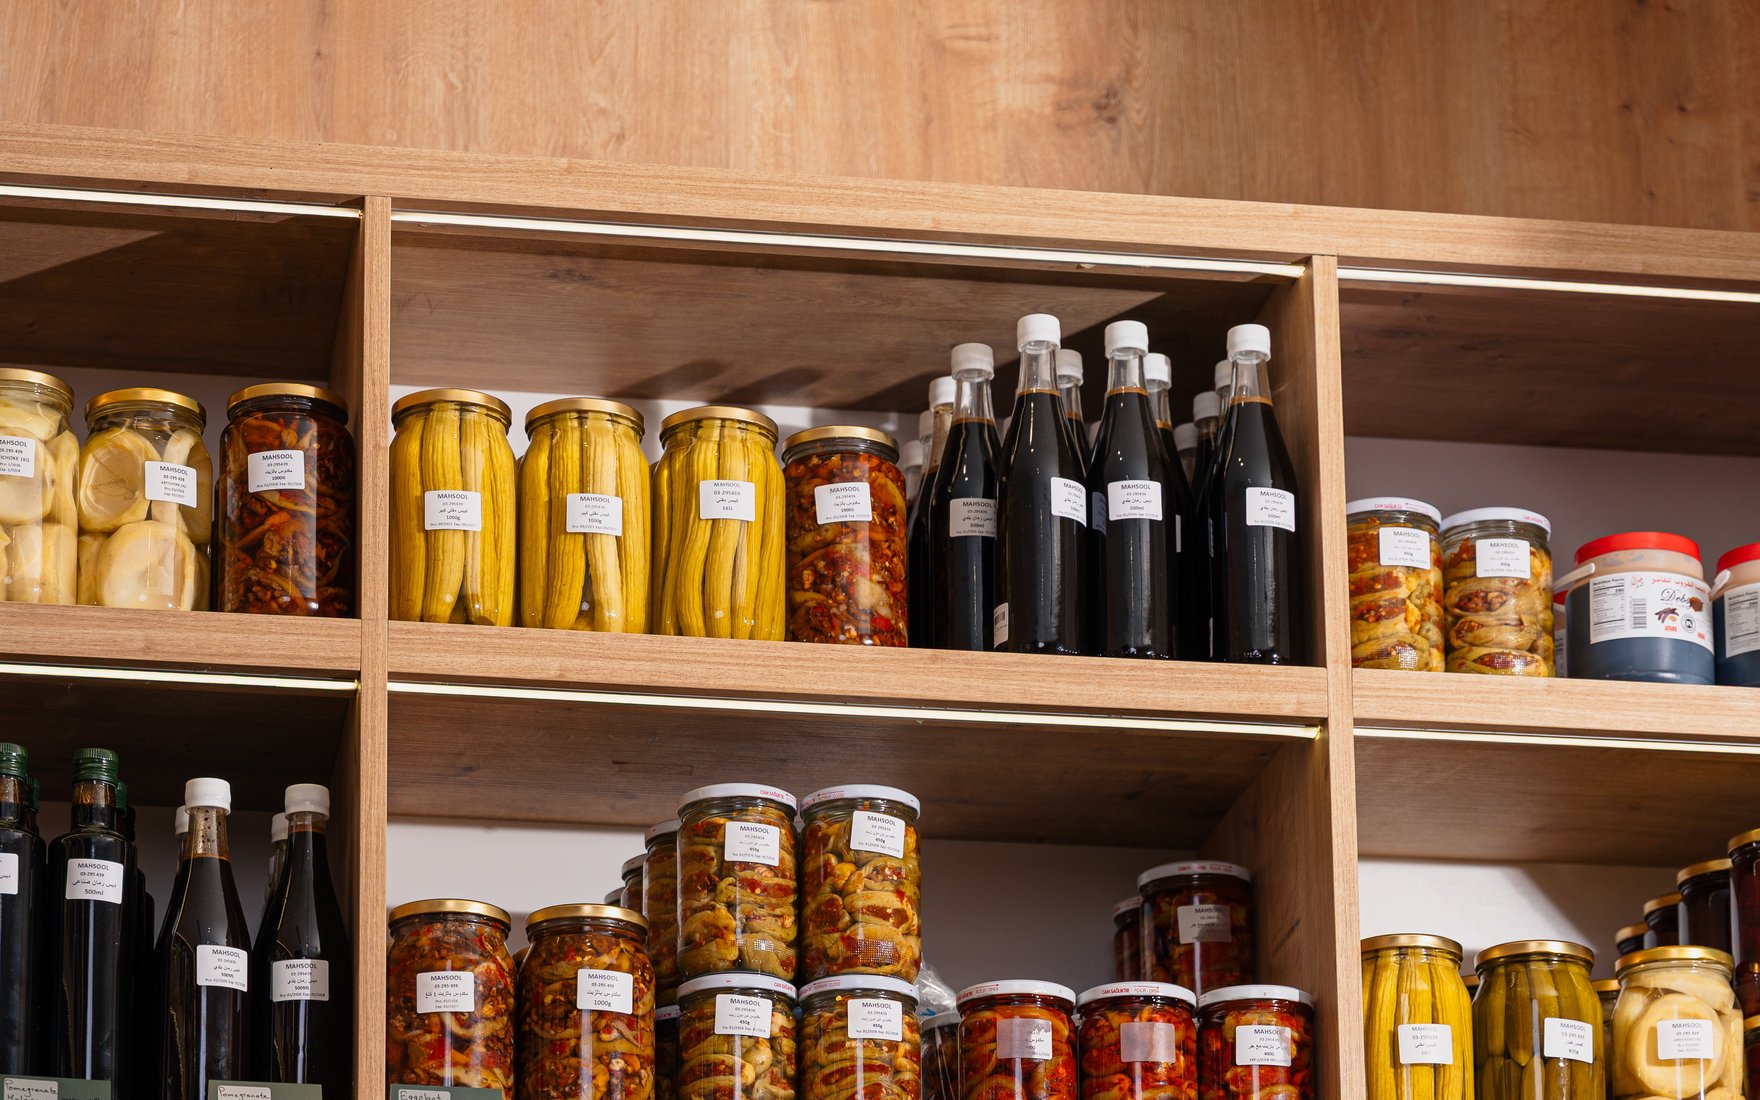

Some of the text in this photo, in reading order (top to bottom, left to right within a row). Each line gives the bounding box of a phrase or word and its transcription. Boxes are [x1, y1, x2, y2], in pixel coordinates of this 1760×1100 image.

[160, 466, 188, 476] MAHSOOL
[830, 486, 860, 494] MAHSOOL
[1260, 491, 1287, 500] MAHSOOL
[867, 815, 896, 826] MAHSOOL
[740, 825, 770, 834] MAHSOOL
[77, 862, 109, 871] MAHSOOL
[84, 888, 104, 896] 500ml
[212, 949, 241, 958] MAHSOOL
[430, 974, 462, 982] MAHSOOL
[588, 973, 619, 982] MAHSOOL
[593, 999, 612, 1007] 1000g
[730, 998, 761, 1007] MAHSOOL
[1560, 1023, 1586, 1032] MAHSOOL
[5, 1080, 59, 1097] Pomegranate
